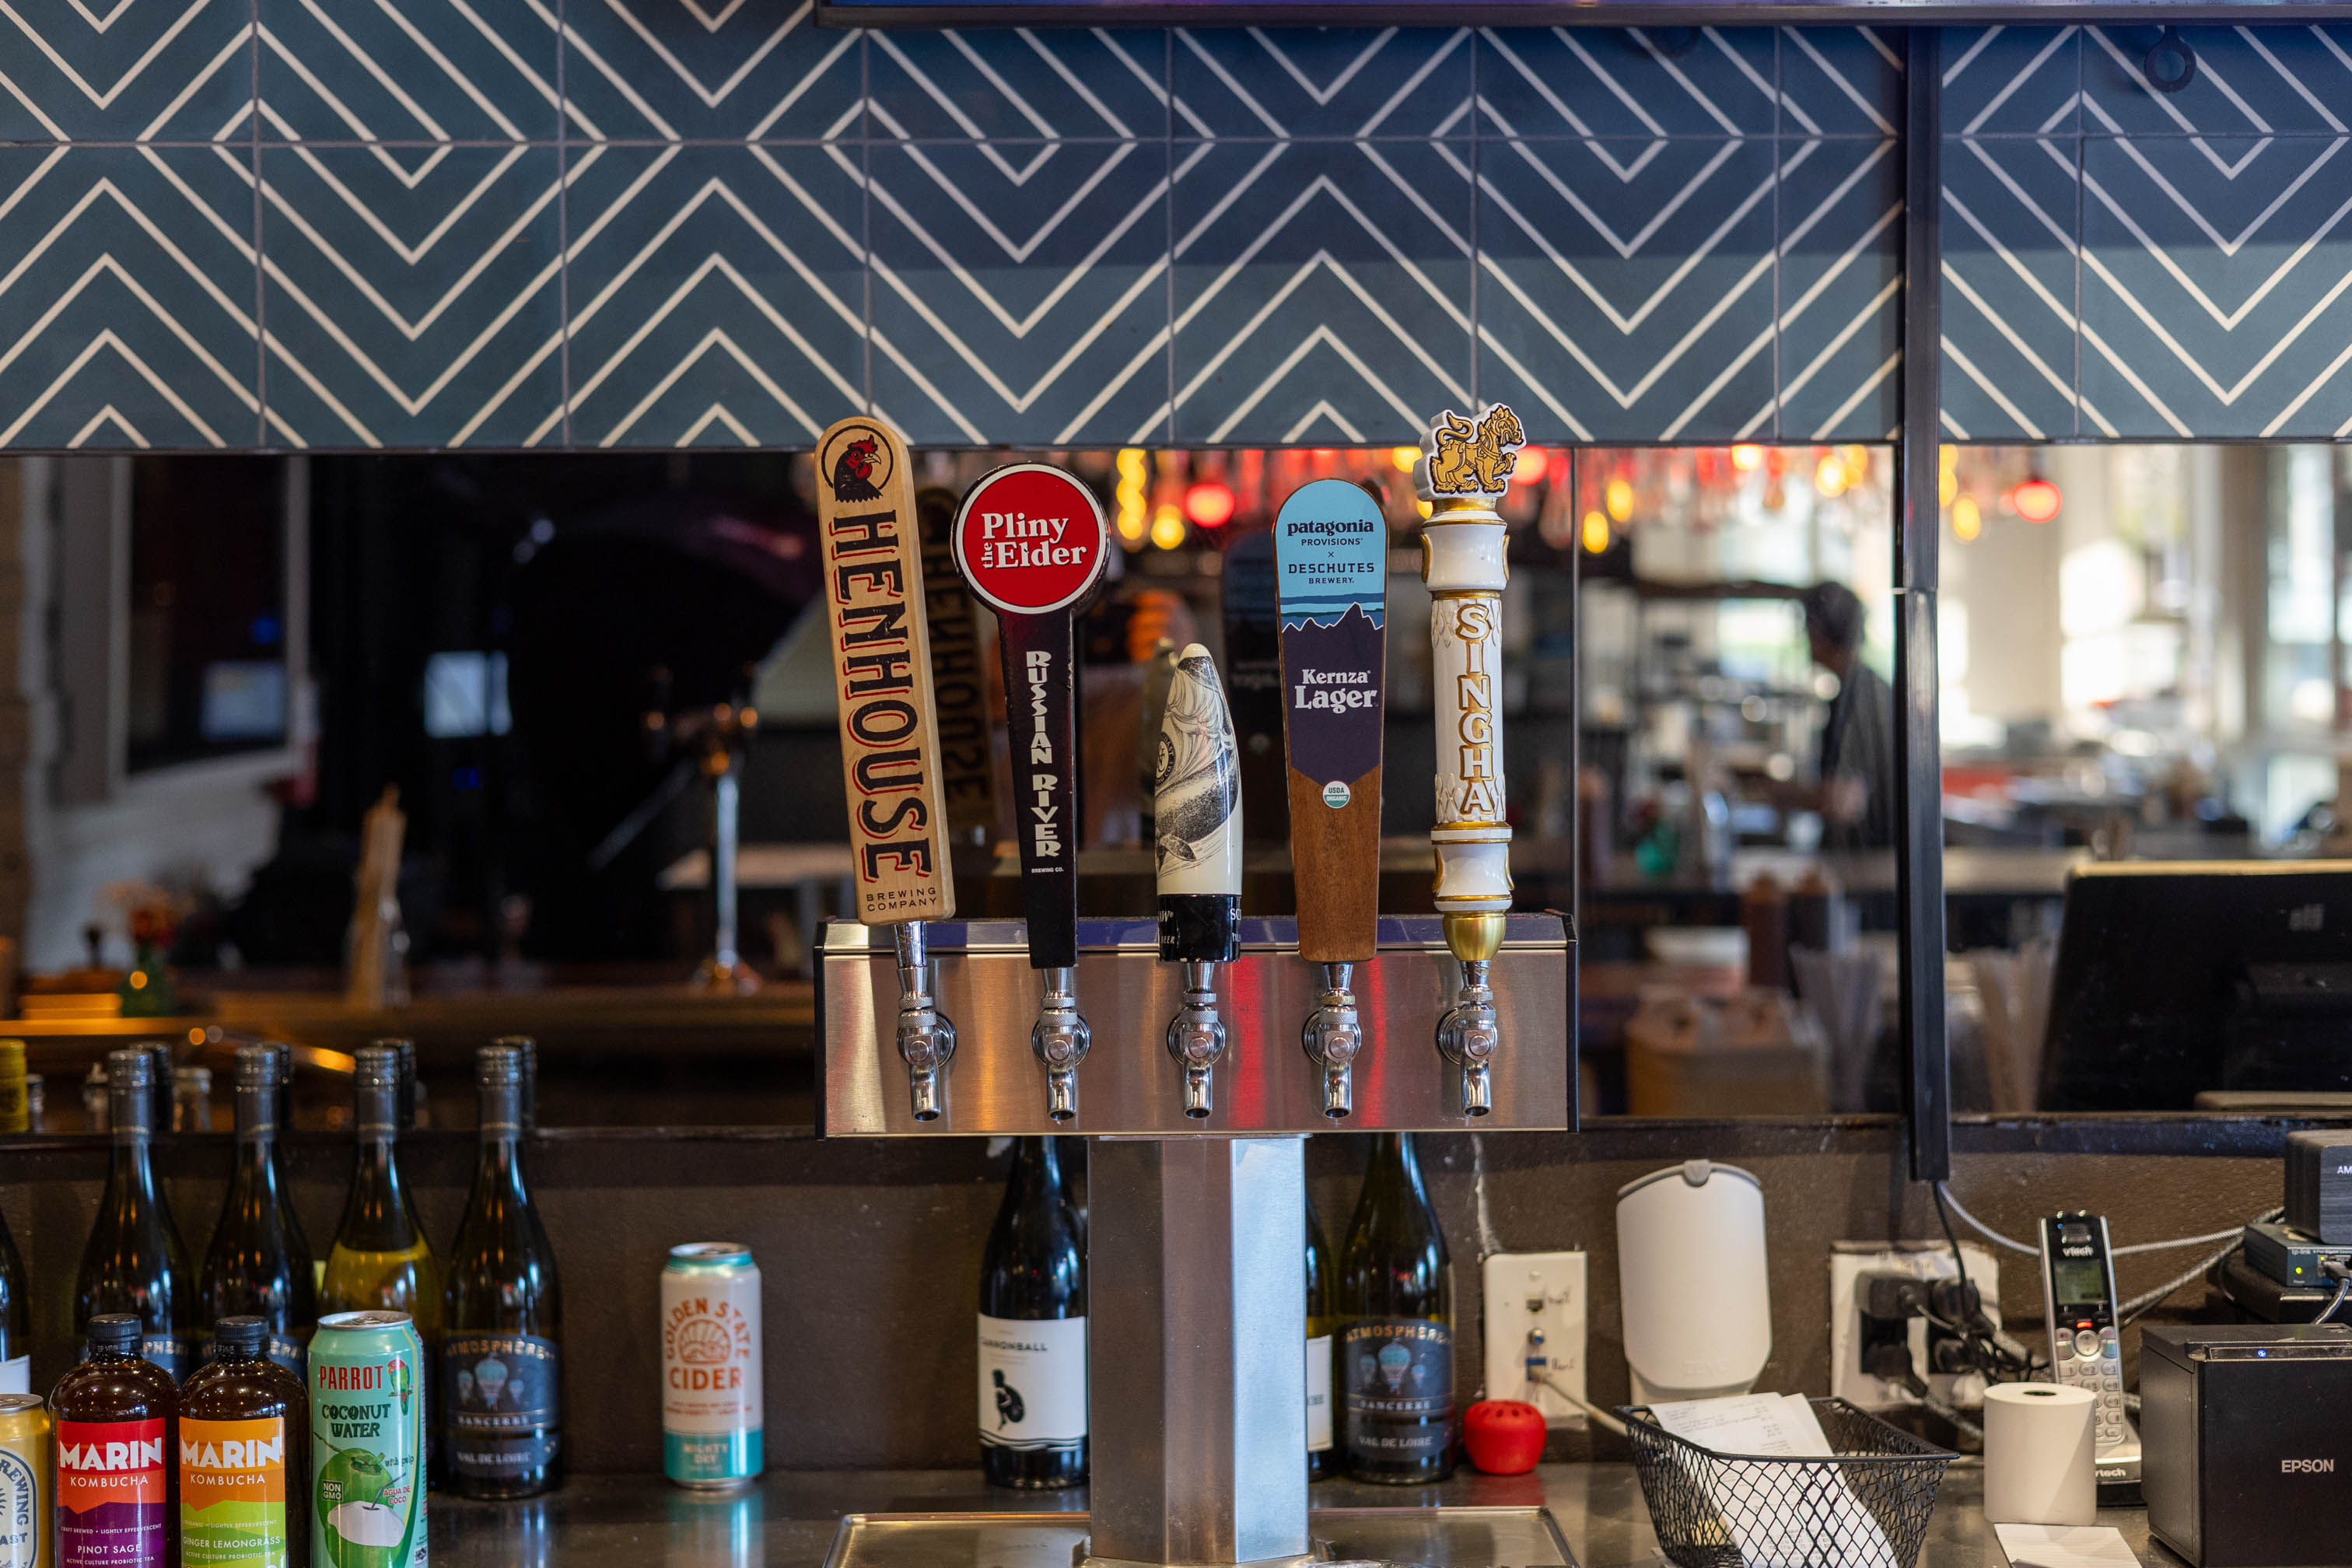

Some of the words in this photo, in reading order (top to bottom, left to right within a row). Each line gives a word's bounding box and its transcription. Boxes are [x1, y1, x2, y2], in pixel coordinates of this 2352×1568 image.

[981, 512, 1069, 543] Pliny
[1287, 519, 1374, 537] patagonia
[982, 541, 994, 569] the
[996, 541, 1087, 569] Elder
[1288, 562, 1375, 574] DESCHUTES
[829, 509, 933, 883] HENHOUSE
[1294, 685, 1377, 714] Lager
[1026, 650, 1052, 765] RUSSIAN
[1456, 604, 1495, 815] SINGHA
[1031, 774, 1062, 859] RIVER
[866, 887, 936, 902] BREWING
[867, 897, 937, 912] COMPANY
[2063, 1245, 2094, 1258] vtech
[664, 1297, 709, 1360] GOLDEN
[715, 1301, 751, 1360] STATE
[320, 1365, 384, 1391] PARROT
[669, 1367, 744, 1390] CIDER
[321, 1403, 391, 1420] COCONUT
[331, 1423, 381, 1438] WATER
[59, 1437, 162, 1472] MARIN
[180, 1436, 281, 1469] MARIN
[2281, 1459, 2335, 1473] EPSON
[70, 1475, 149, 1488] KOMBUCHA
[190, 1474, 266, 1486] KOMBUCHA
[323, 1482, 341, 1491] NON
[0, 1458, 29, 1526] REWING
[323, 1491, 342, 1500] GMO
[383, 1486, 402, 1496] AGUA
[388, 1496, 407, 1505] COCO
[77, 1545, 108, 1554] PINOT
[113, 1544, 142, 1552] SAGE
[183, 1536, 209, 1548] GINGER
[213, 1535, 280, 1549] LEMONGRASS
